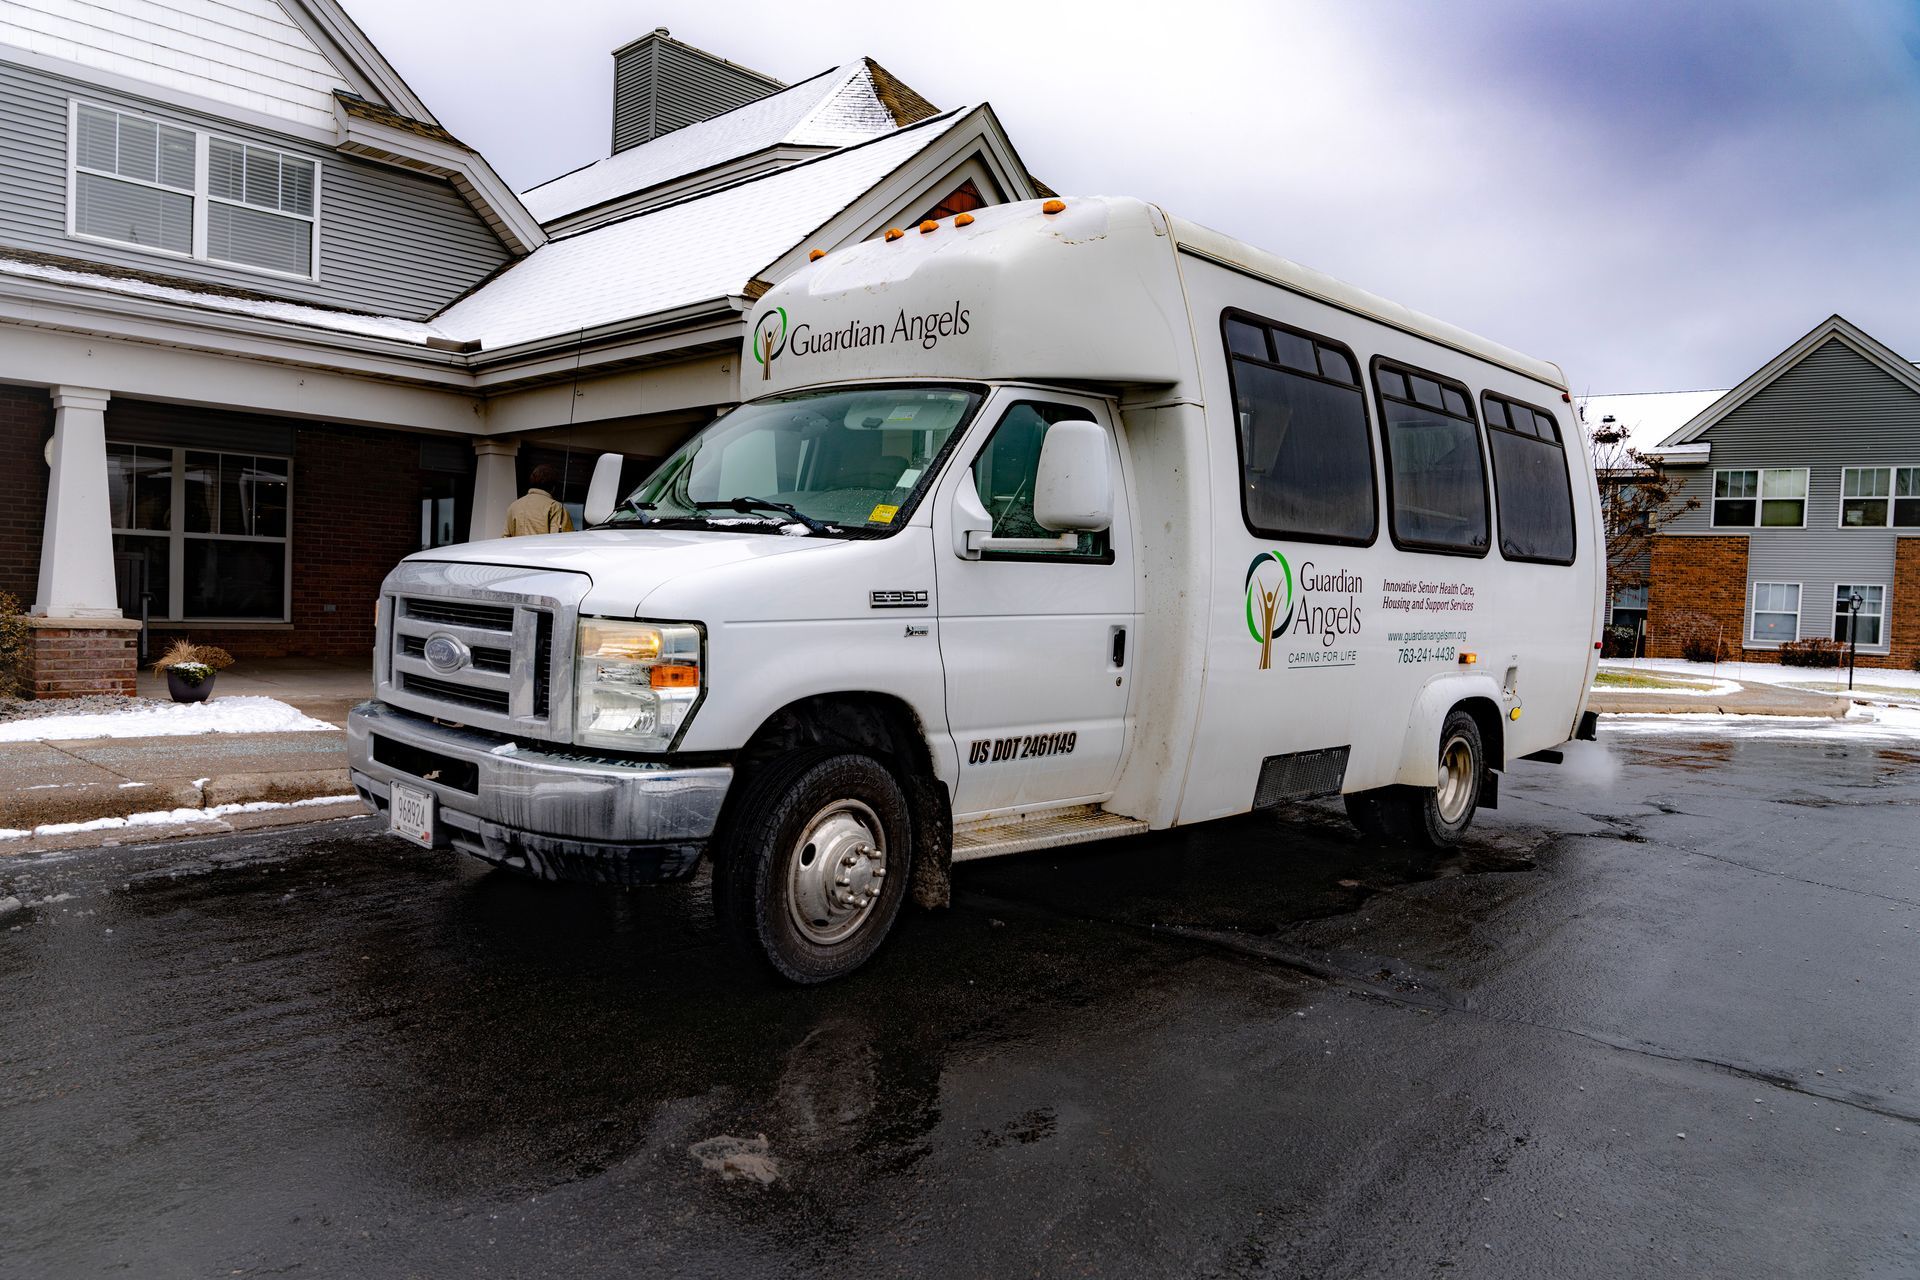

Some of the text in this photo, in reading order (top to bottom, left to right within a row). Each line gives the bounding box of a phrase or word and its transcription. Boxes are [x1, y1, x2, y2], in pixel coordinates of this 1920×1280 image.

[790, 300, 971, 357] Guardian Angels
[1300, 561, 1363, 593] Guardian
[1382, 578, 1475, 597] Innovative Senior Health Care,
[1382, 596, 1474, 613] Housing and Support Services
[1293, 594, 1361, 647] Angels
[1387, 629, 1467, 644] www.guardianangelsmn.org
[1288, 650, 1357, 664] CARING FOR LIFE
[1398, 646, 1455, 664] 763-241-4438
[969, 731, 1078, 765] US DOT 2461149
